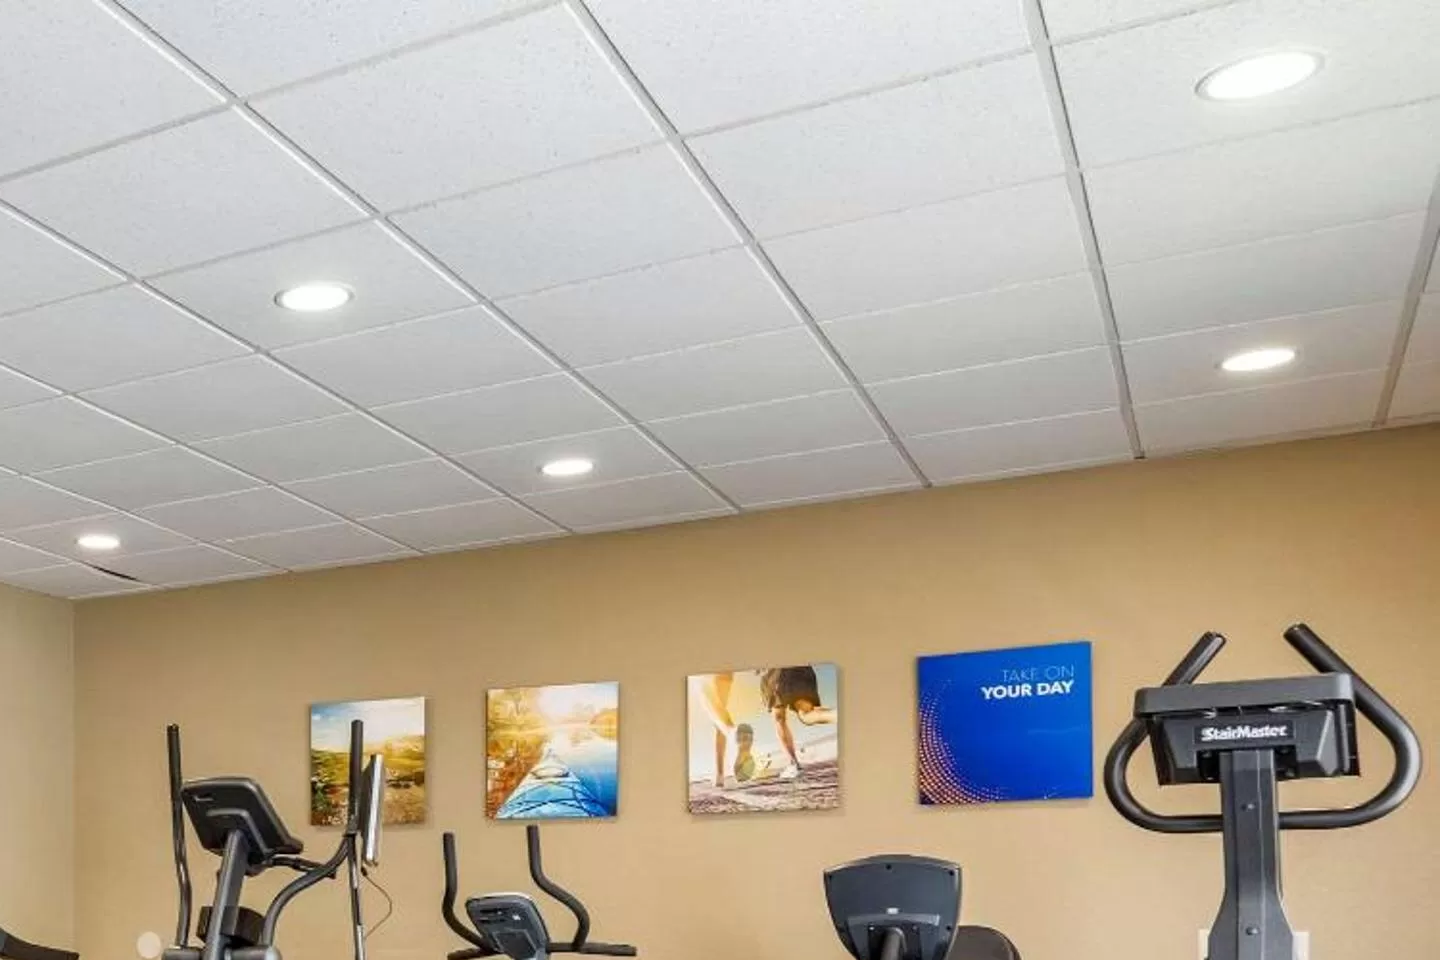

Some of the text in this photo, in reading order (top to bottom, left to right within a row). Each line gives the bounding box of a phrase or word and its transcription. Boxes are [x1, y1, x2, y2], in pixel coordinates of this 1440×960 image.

[1002, 664, 1074, 682] TAKE ON
[981, 680, 1074, 699] YOUR DAY
[1201, 725, 1288, 741] StairMaster
